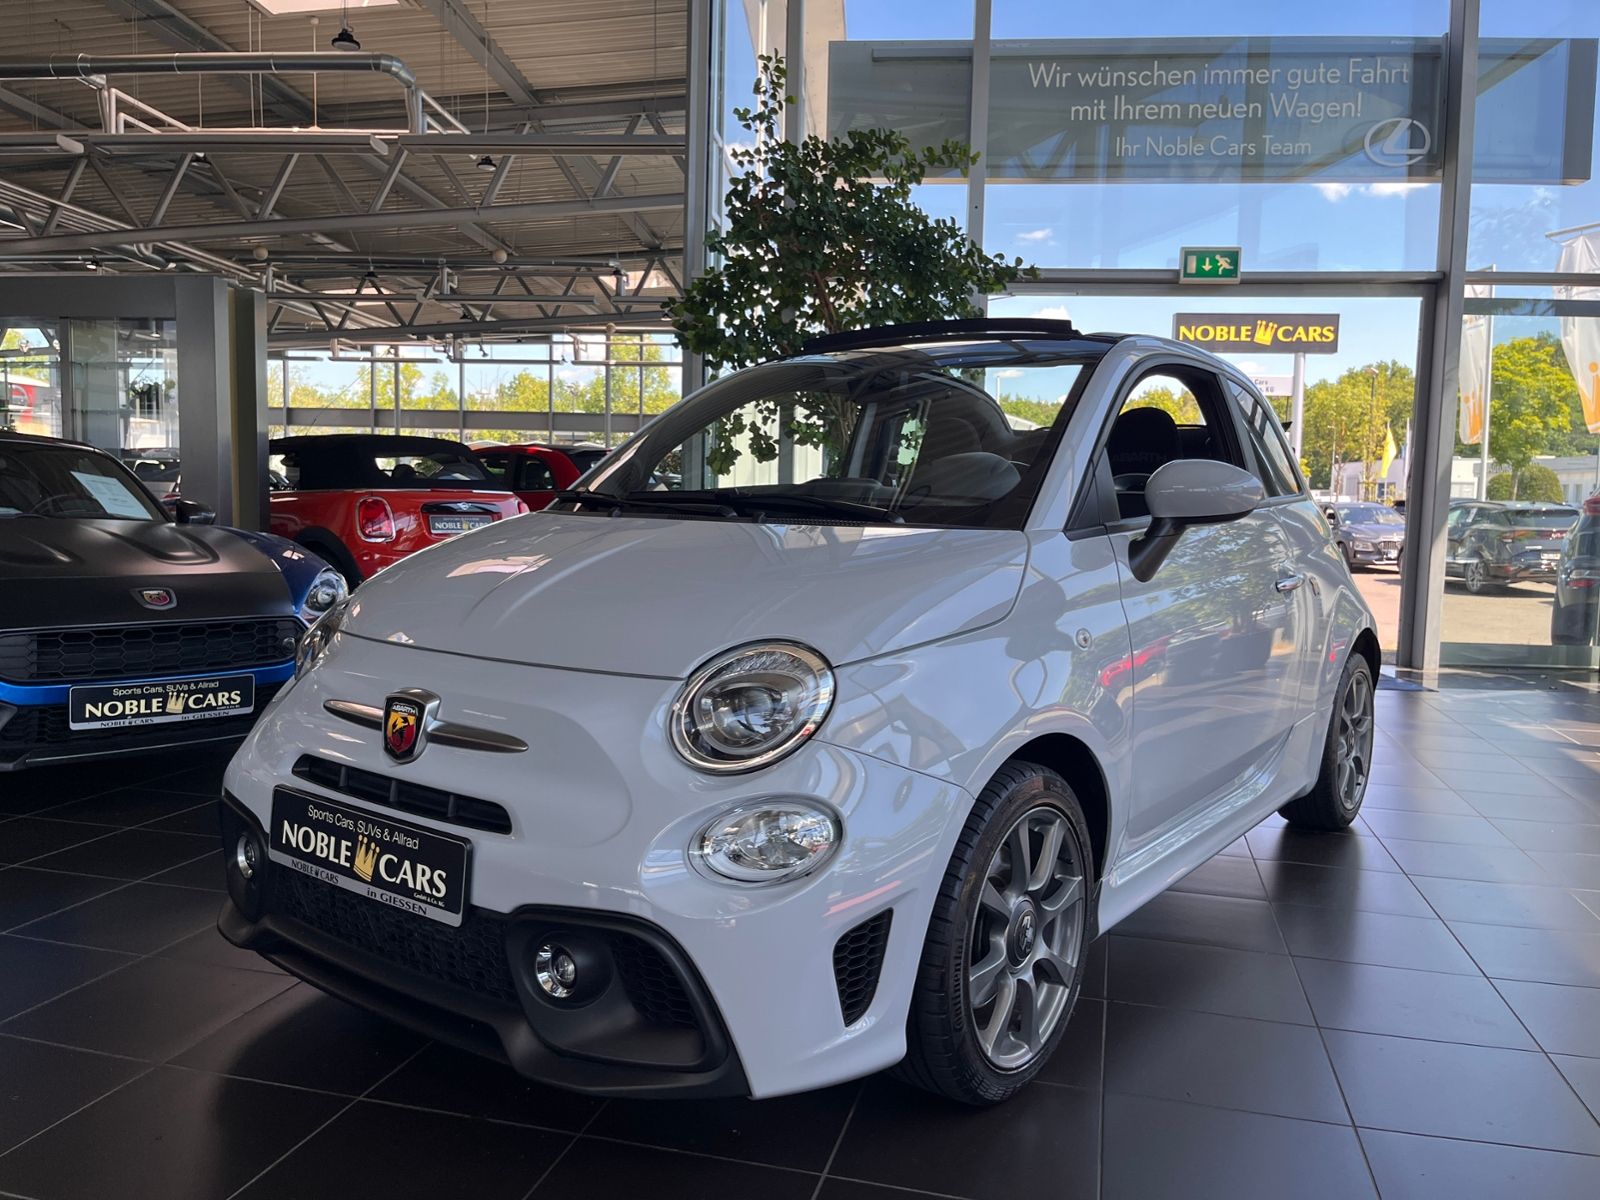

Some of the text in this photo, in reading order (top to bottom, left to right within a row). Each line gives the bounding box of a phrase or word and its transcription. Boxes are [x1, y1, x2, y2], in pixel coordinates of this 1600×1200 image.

[1028, 57, 1409, 90] Wir wünschen immer gute Fahrt
[1070, 91, 1363, 123] mit Ihrem neuen Wagen!
[1115, 134, 1313, 157] Ihr Noble Cars Team
[1179, 325, 1335, 343] NOBLE CARS
[434, 522, 461, 530] NOBLE
[112, 686, 142, 697] Sports
[142, 685, 165, 695] Cars,
[166, 683, 188, 693] SUVs
[197, 681, 220, 690] Allrad
[85, 690, 241, 718] NOBLE CARS
[392, 704, 416, 714] ABARTH
[100, 719, 127, 728] NOBLE
[133, 718, 155, 726] CARS
[191, 711, 230, 721] GIESSEN
[307, 804, 420, 850] Sports Cars, SUVs & Allrad
[282, 819, 447, 898] NOBLE CARS
[291, 859, 339, 884] NOBLE CARS
[366, 887, 428, 916] in GIESSEN
